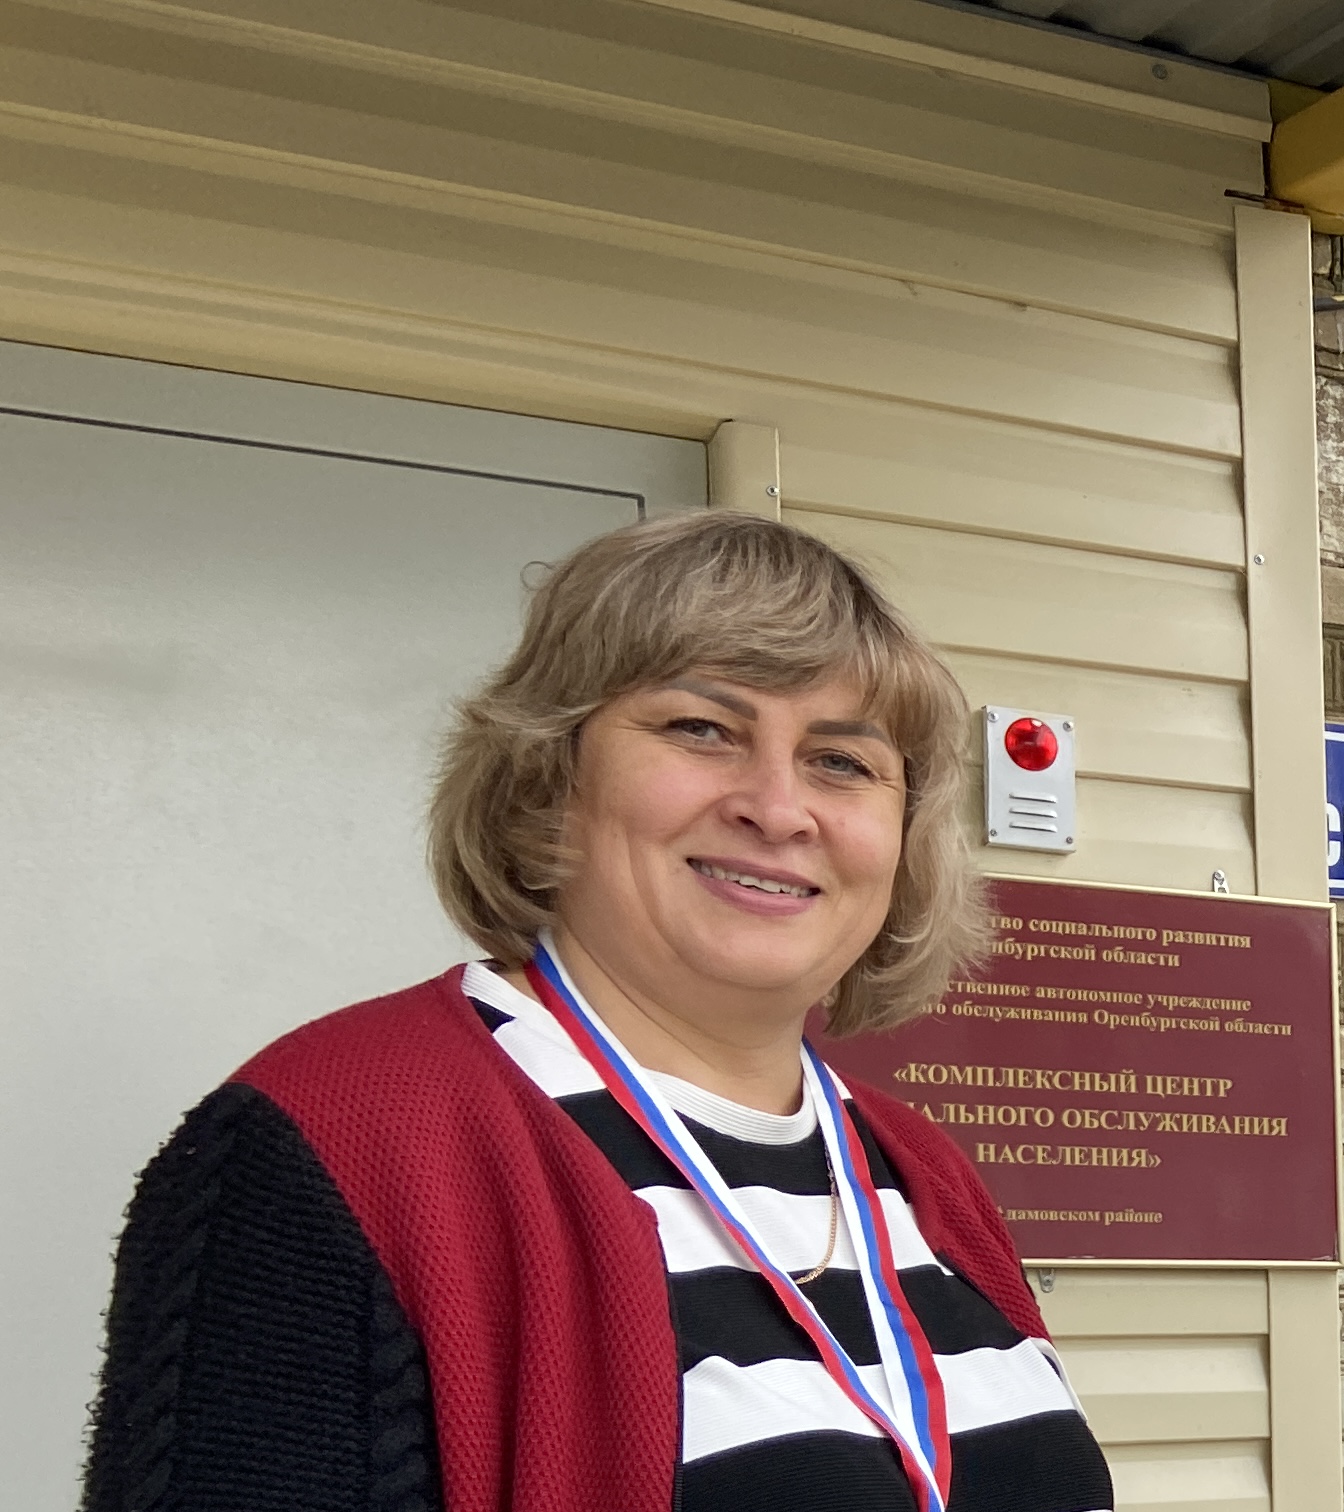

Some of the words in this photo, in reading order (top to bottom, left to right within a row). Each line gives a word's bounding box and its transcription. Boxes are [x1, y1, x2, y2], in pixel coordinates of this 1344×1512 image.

[1029, 917, 1157, 941] социального
[1162, 928, 1252, 949] развития
[991, 937, 1096, 961] нбургской
[1102, 946, 1180, 967] области
[1035, 984, 1143, 1005] автономное
[1147, 993, 1252, 1012] учреждение
[952, 1000, 1088, 1024] обслуживания
[1093, 1008, 1220, 1033] Оренбургской
[1224, 1017, 1292, 1036] области
[893, 1062, 1138, 1094] «КОМПЛЕКСНЫЙ
[1145, 1074, 1233, 1098] ЦЕНТР
[904, 1101, 1055, 1128] АЛЬНОГО
[1062, 1108, 1288, 1137] ОБСЛУЖИВАНИЯ
[975, 1142, 1162, 1168] НАСЕЛЕНИЯ»
[1104, 1207, 1163, 1226] районе
